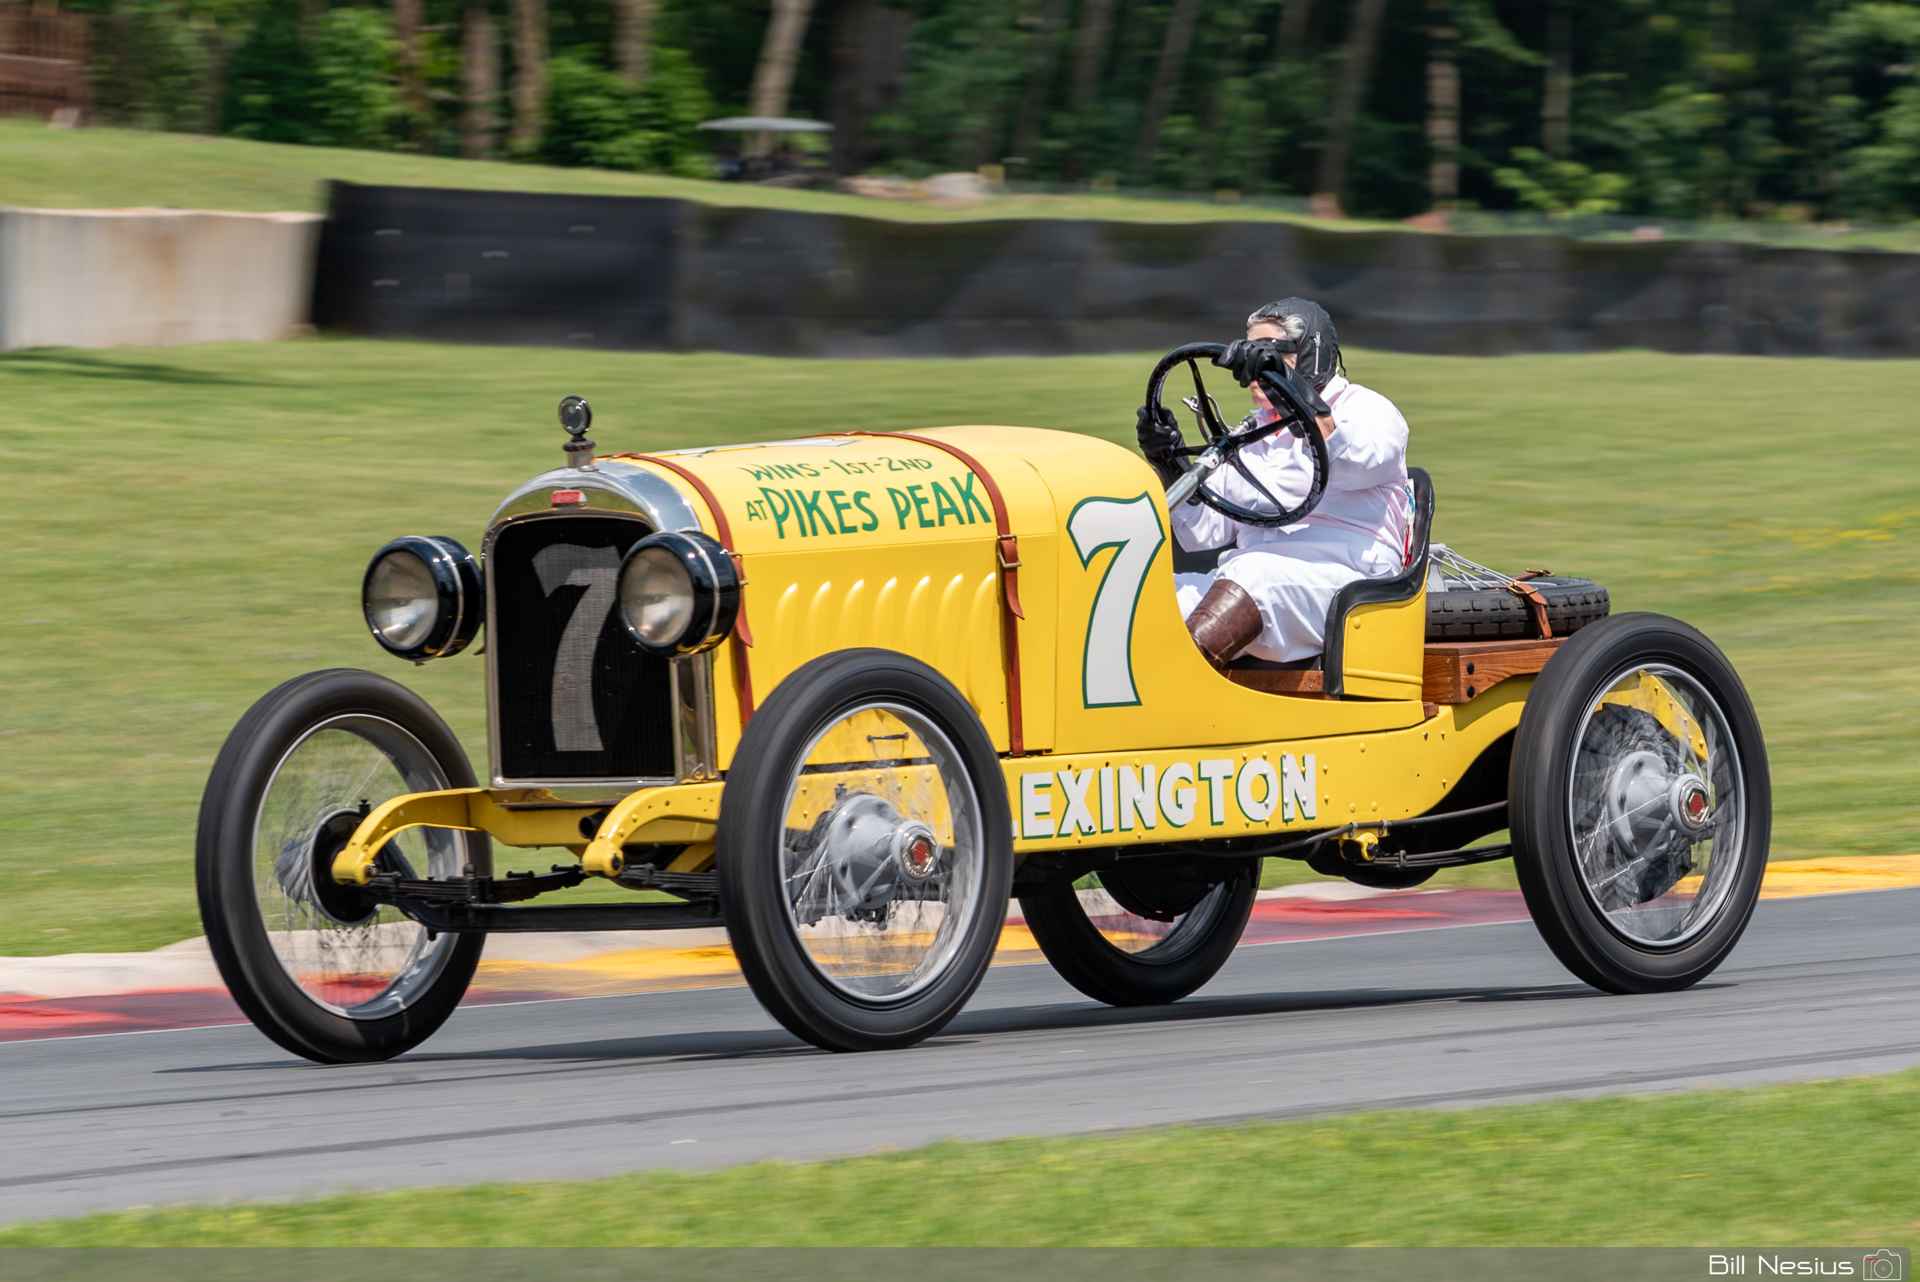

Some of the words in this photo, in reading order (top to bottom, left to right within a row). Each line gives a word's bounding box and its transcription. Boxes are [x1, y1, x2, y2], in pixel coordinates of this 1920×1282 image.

[745, 499, 768, 522] AT
[759, 487, 879, 540] PIKES
[886, 471, 993, 531] PEAK
[1066, 490, 1167, 710] 7
[531, 543, 621, 752] 7
